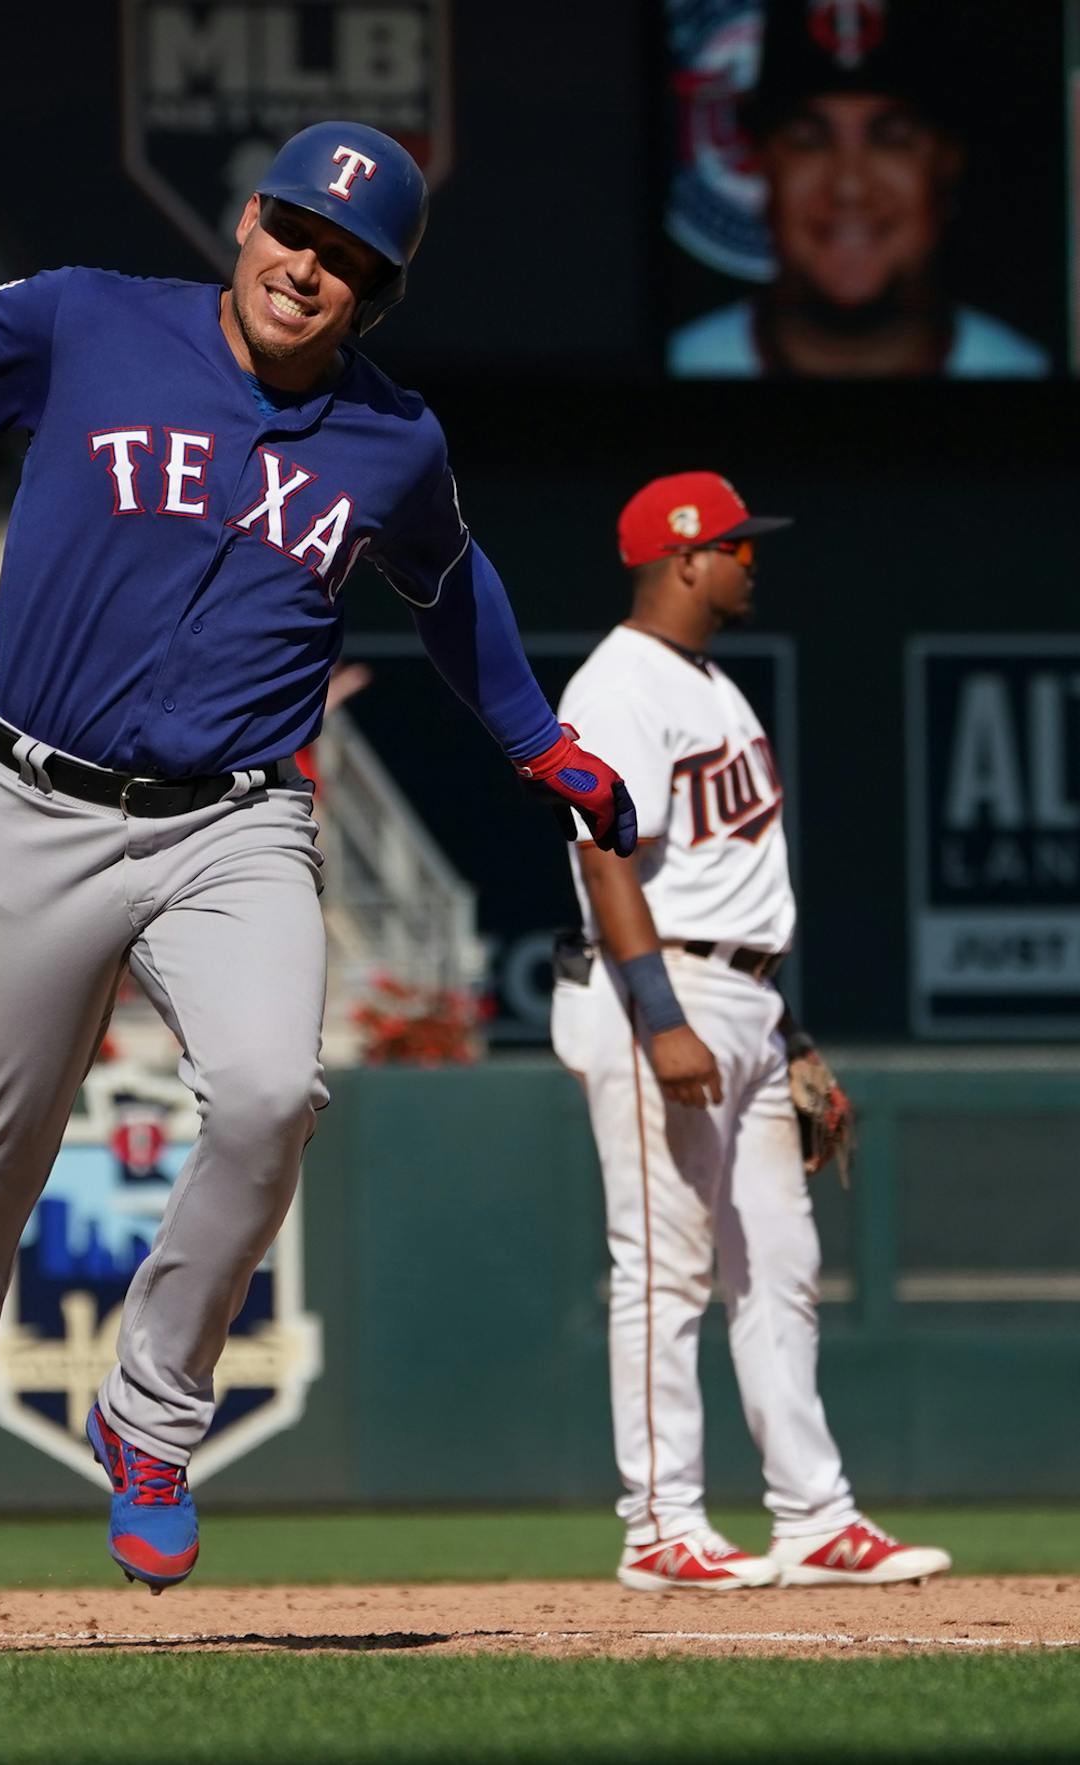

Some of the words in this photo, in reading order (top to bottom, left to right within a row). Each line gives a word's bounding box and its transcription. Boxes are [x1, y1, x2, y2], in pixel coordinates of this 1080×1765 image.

[148, 2, 426, 95] MLB
[328, 145, 376, 200] T
[946, 673, 1080, 827] AL
